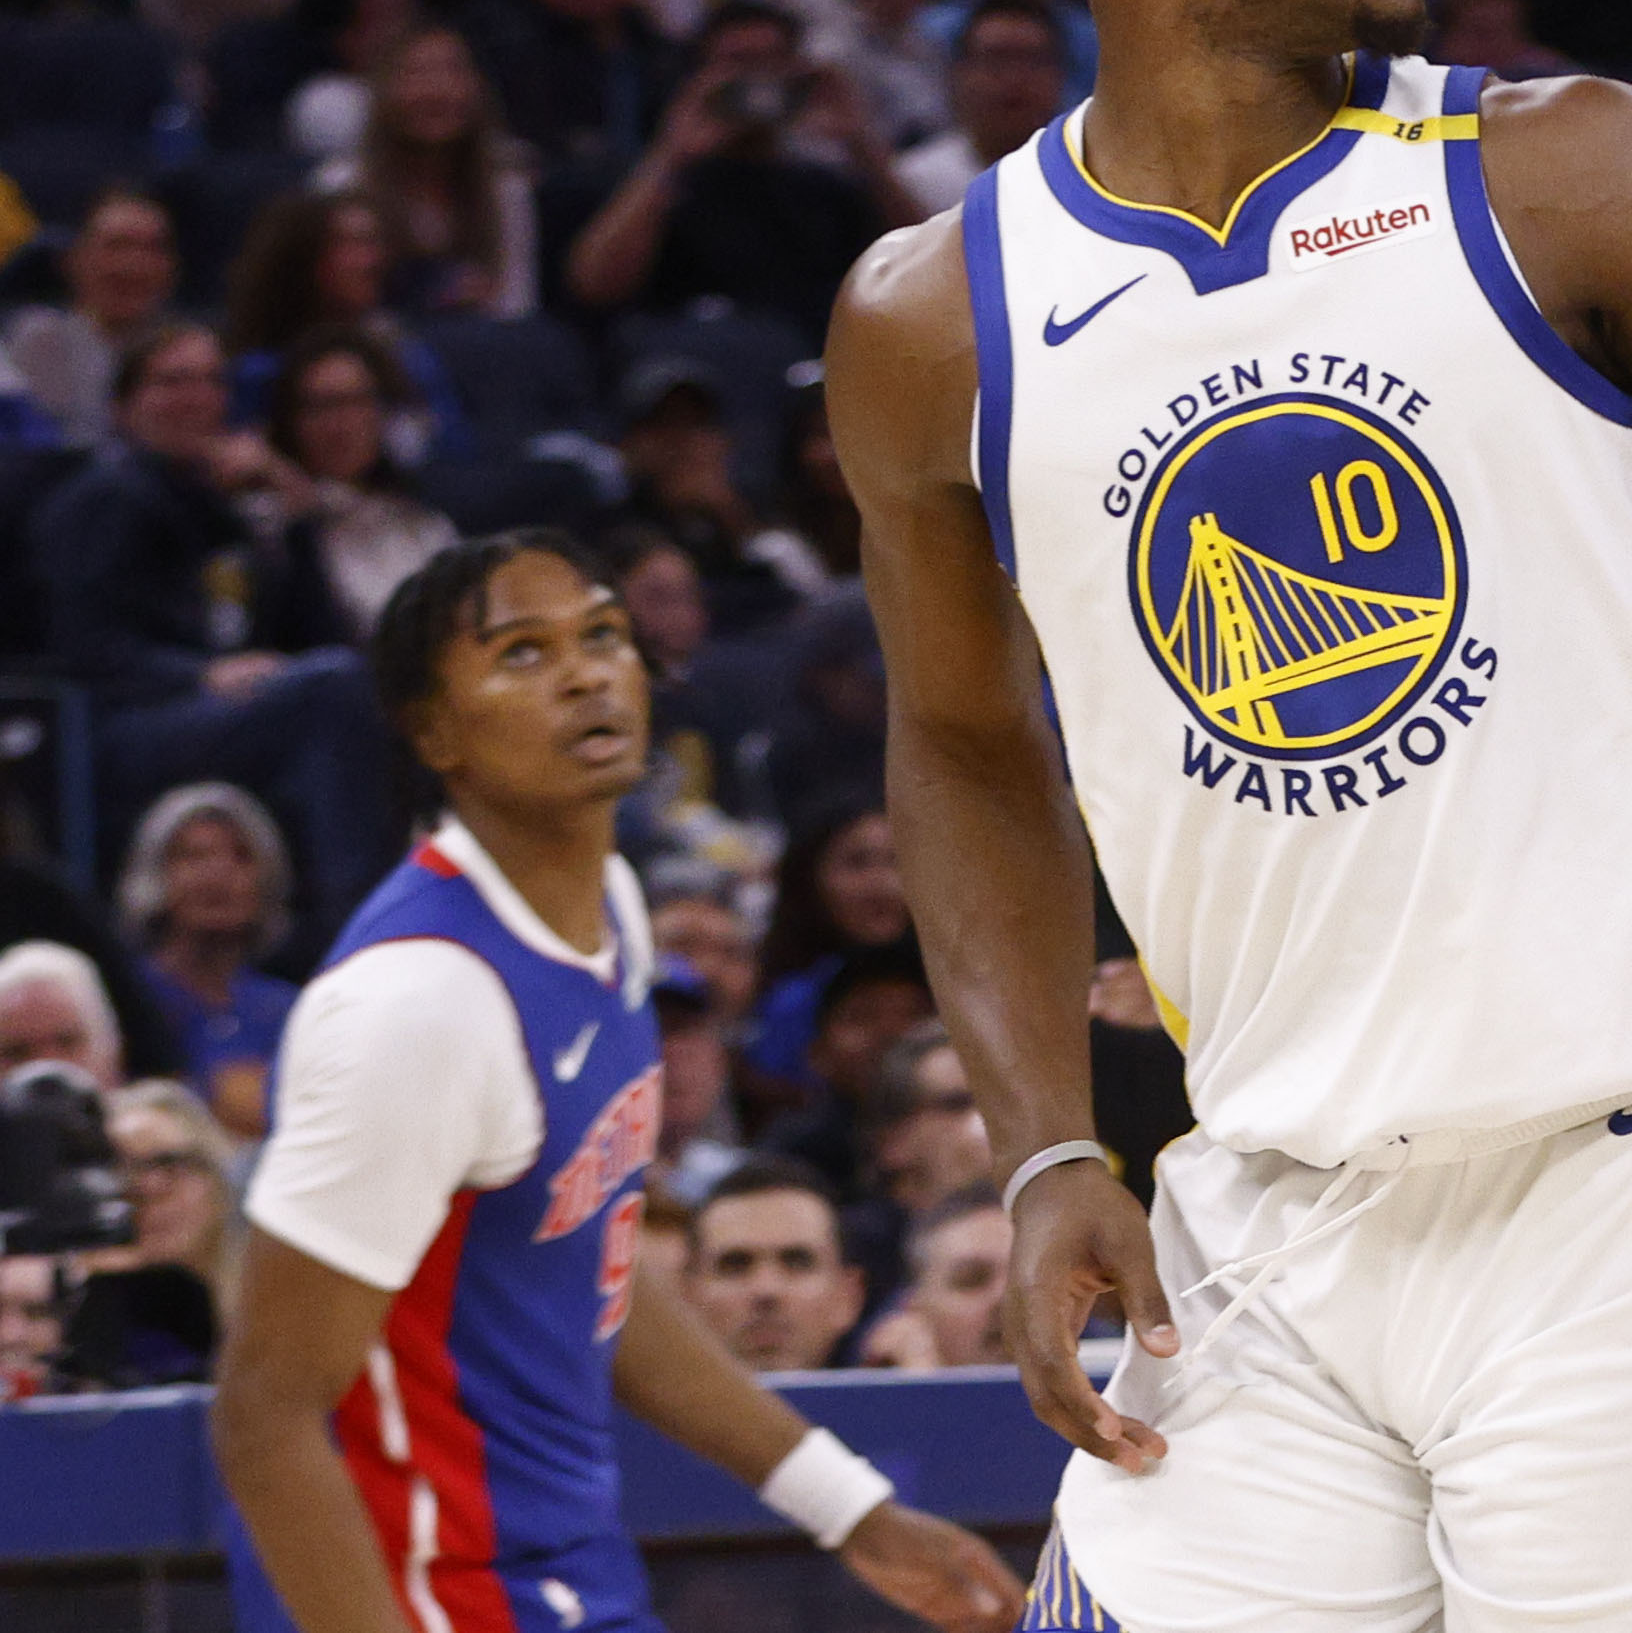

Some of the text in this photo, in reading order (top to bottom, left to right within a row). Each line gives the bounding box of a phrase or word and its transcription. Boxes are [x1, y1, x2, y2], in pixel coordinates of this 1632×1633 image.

[1393, 122, 1425, 142] 16
[1290, 203, 1431, 257] Rakuten
[1103, 352, 1432, 519] GOLDEN STATE
[1308, 459, 1400, 565] 10
[1181, 636, 1499, 818] WARRIORS
